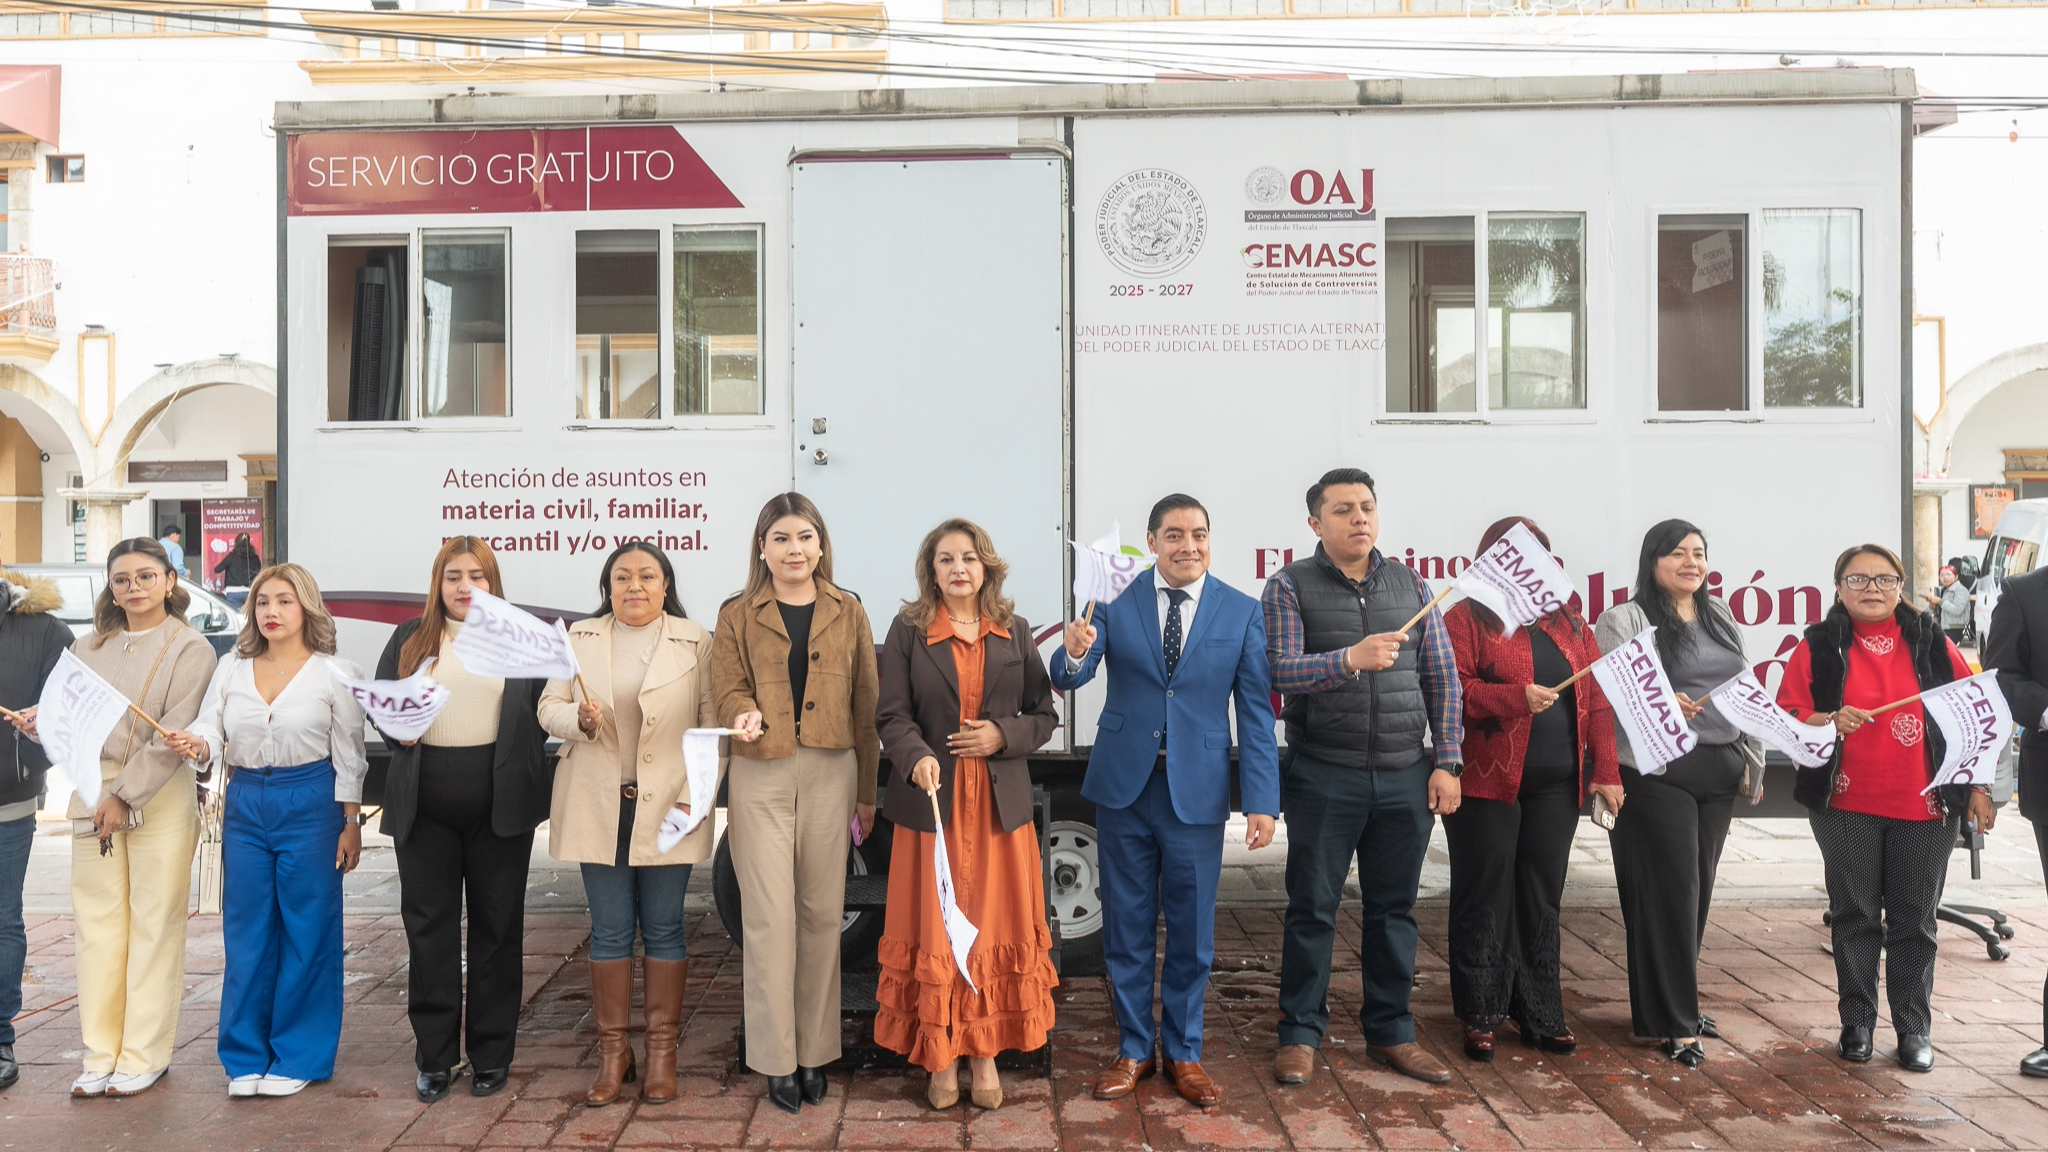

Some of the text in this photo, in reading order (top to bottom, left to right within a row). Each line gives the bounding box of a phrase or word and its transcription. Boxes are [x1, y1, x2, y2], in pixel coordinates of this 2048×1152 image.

[308, 149, 675, 188] SERVICIO GRATUITO
[1131, 181, 1161, 193] UNIDOS
[1290, 168, 1375, 214] OAJ
[1098, 170, 1205, 257] PODER JUDICIAL DEL ESTADO DE TLAXCALA
[1248, 211, 1271, 221] Órgano
[1281, 211, 1328, 219] Administración
[1329, 211, 1353, 220] Judicial
[1291, 223, 1318, 231] Tlaxcala
[1241, 242, 1377, 268] CEMASC
[1246, 271, 1378, 279] Centro Estatal de Mecanismos Alternativos
[1109, 284, 1144, 297] 2025
[1158, 283, 1194, 296] 2027
[1260, 280, 1299, 288] Solución
[1301, 280, 1312, 288] de
[1315, 280, 1378, 288] Controversias
[1279, 289, 1304, 297] Judicial
[1351, 288, 1378, 296] Tlaxcala
[1075, 324, 1131, 337] UNIDAD
[1135, 324, 1218, 337] ITINERANTE
[1222, 323, 1241, 336] DE
[1244, 323, 1307, 336] JUSTICIA
[1075, 341, 1099, 353] DEL
[1103, 340, 1151, 353] PODER
[1155, 340, 1219, 353] JUDICIAL
[1223, 339, 1249, 352] DEL
[1253, 339, 1309, 352] ESTADO
[1312, 339, 1331, 352] DE
[442, 466, 707, 489] Atención de asuntos en
[206, 507, 247, 516] SECRETARÍA
[442, 497, 709, 523] materia civil, familiar,
[204, 522, 260, 530] COMPETITIVIDAD
[441, 530, 559, 551] cantil
[567, 530, 607, 555] y/o
[1255, 548, 1294, 580] El
